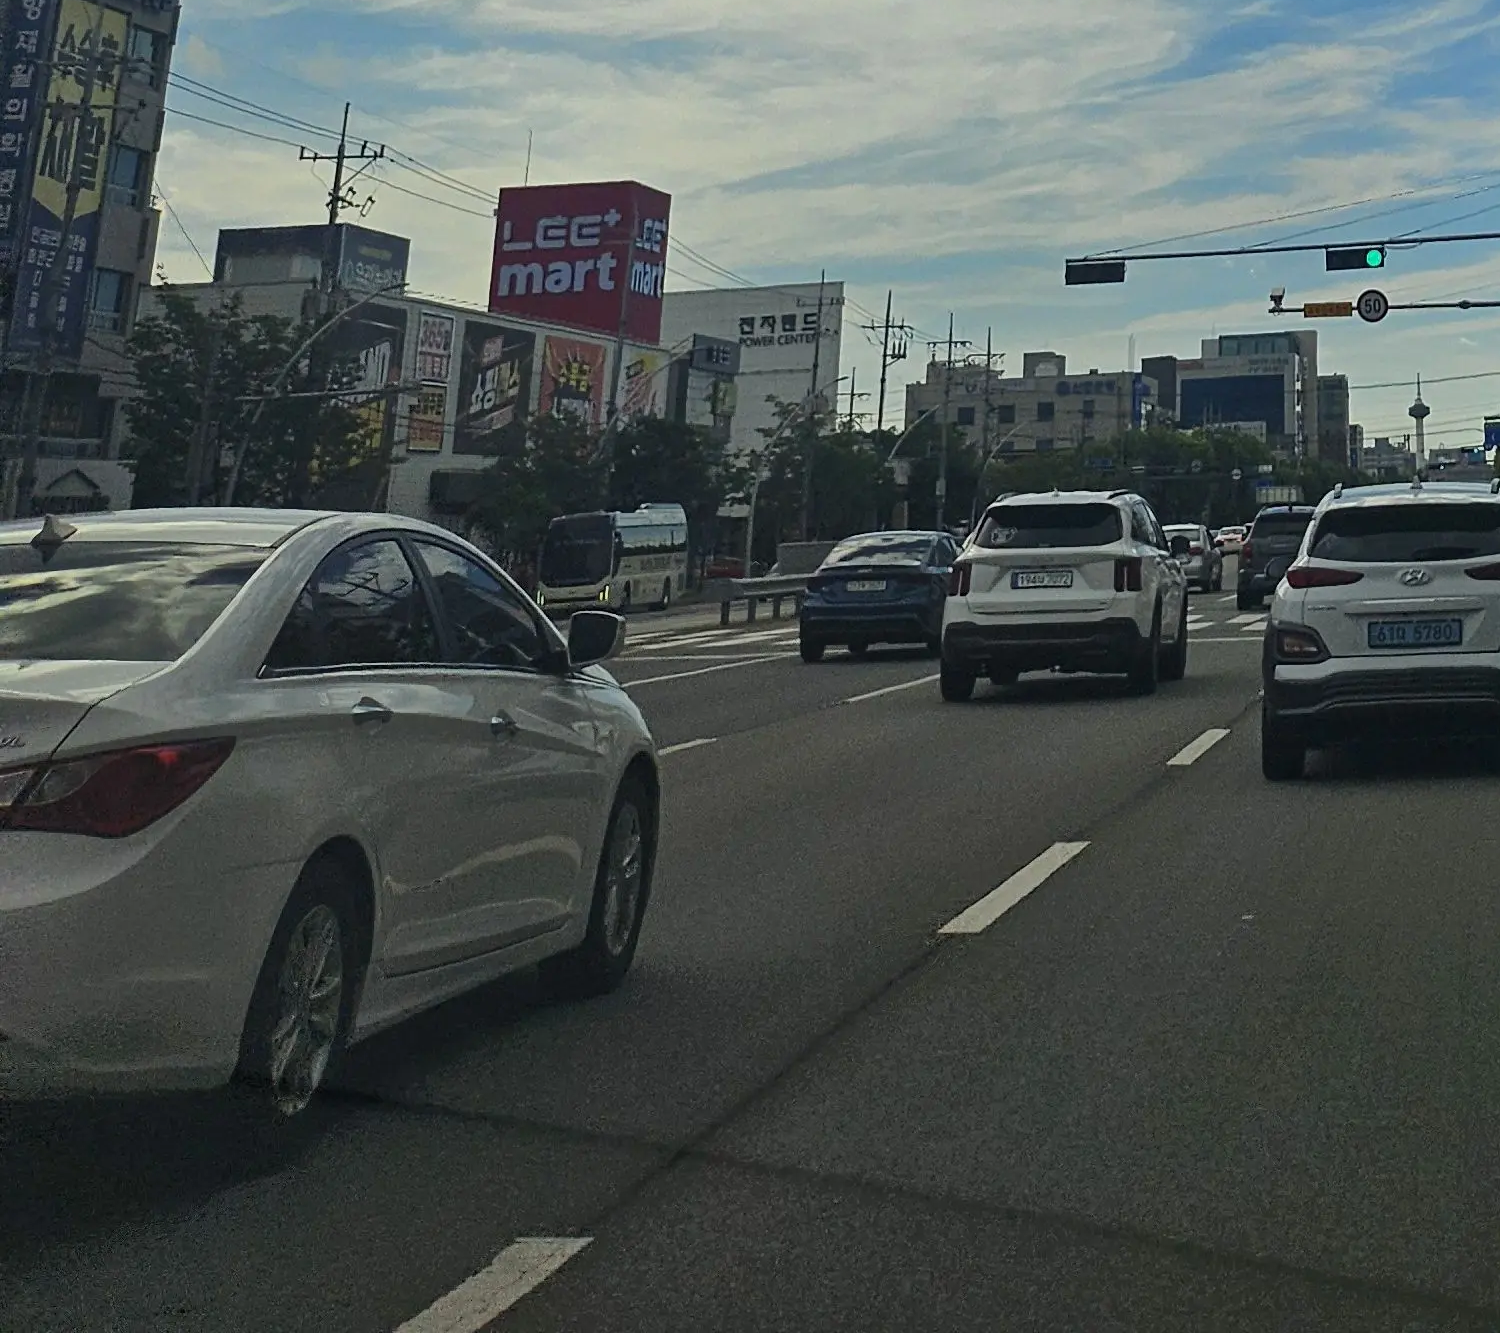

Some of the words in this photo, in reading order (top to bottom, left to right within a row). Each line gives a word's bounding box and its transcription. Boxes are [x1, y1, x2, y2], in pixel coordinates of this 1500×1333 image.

[497, 252, 617, 297] mart
[631, 260, 664, 299] mart
[1364, 298, 1382, 314] 50
[738, 335, 776, 347] POWER
